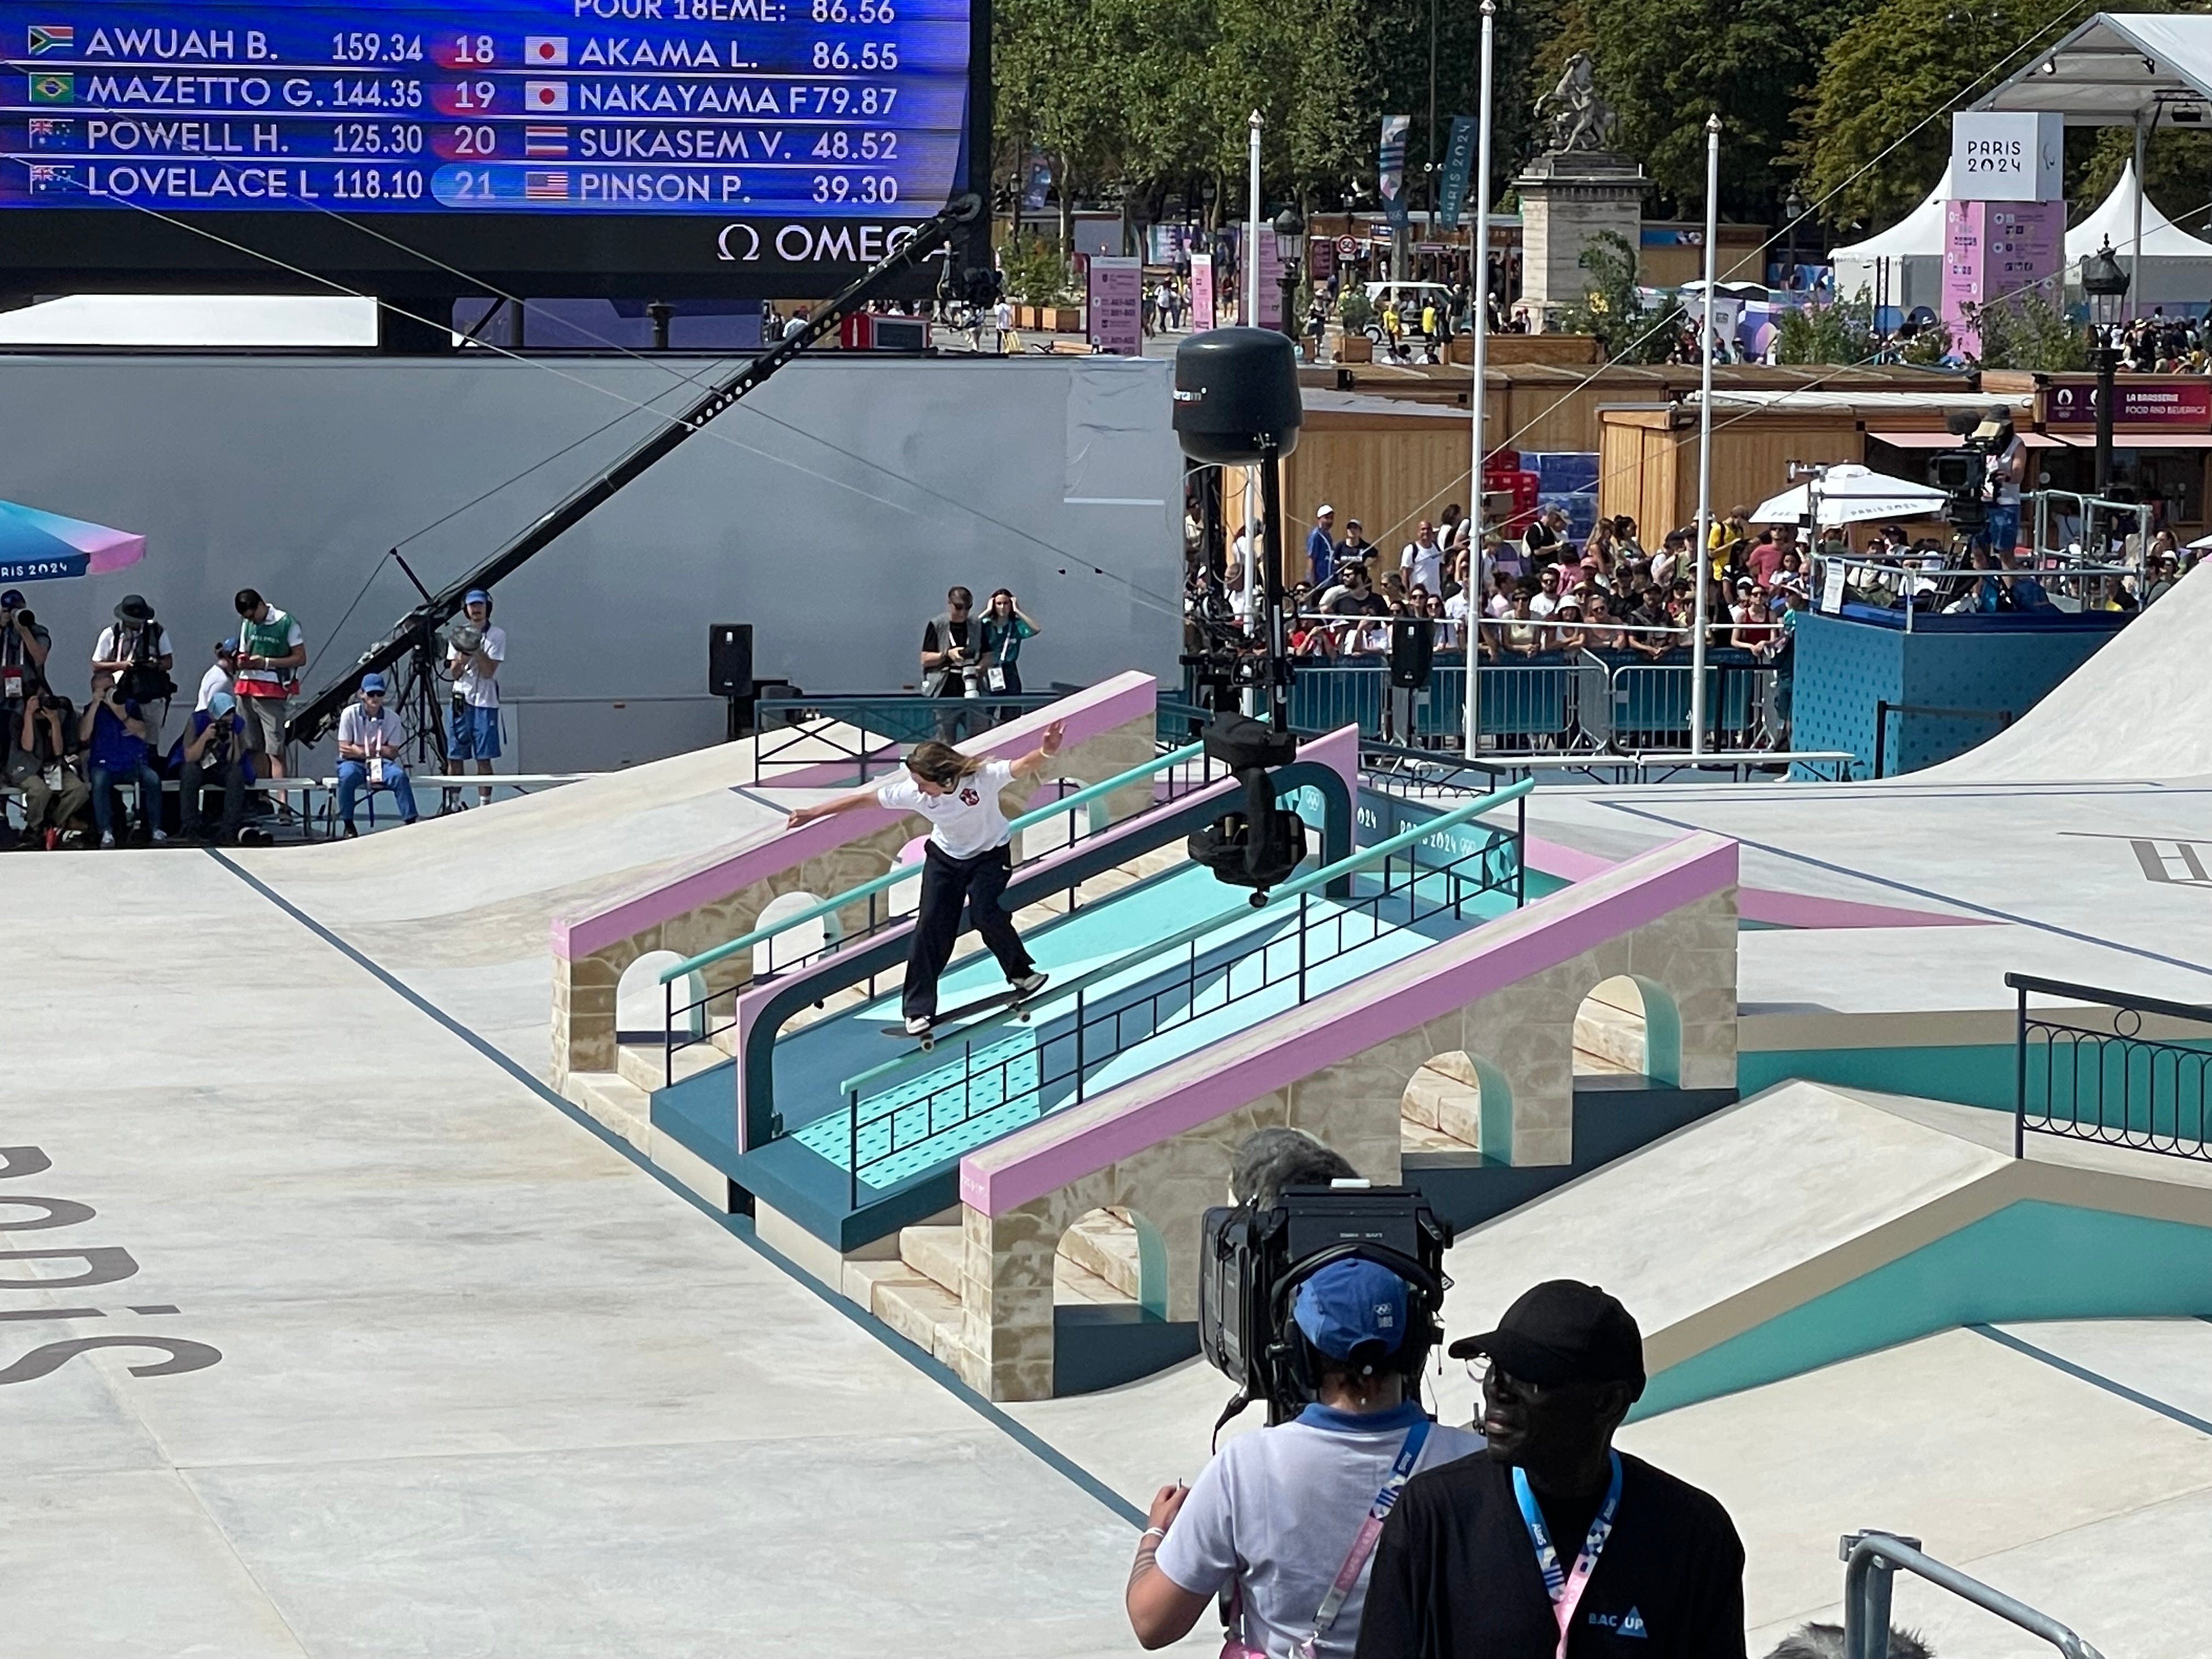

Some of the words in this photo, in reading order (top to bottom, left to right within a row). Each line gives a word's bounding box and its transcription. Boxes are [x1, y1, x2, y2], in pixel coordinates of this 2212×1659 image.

[574, 0, 663, 19] POUR
[811, 0, 895, 24] 86.56
[85, 28, 235, 60] AWUAH
[246, 32, 279, 60] B.
[332, 32, 424, 62] 159.34
[455, 35, 494, 63] 18
[578, 37, 720, 68] AKAMA
[731, 40, 758, 69] L.
[812, 42, 898, 70] 86.55
[87, 75, 271, 106] MAZETTO
[283, 78, 324, 108] G.
[332, 80, 422, 108] 144.35
[455, 80, 495, 108] 19
[579, 83, 781, 114] NAKAYAMA
[790, 87, 807, 113] F
[813, 87, 898, 115] 79.87
[88, 121, 243, 151] POWELL
[254, 124, 289, 153] H.
[333, 124, 423, 154] 125.30
[454, 126, 496, 155] 20
[579, 128, 749, 159] SUKASEM
[759, 131, 792, 159] V.
[811, 131, 898, 160] 48.52
[1452, 124, 1470, 167] 2024
[1967, 140, 2021, 155] PARIS
[1967, 159, 2021, 173] 2024
[88, 167, 287, 197] LOVELACE
[300, 170, 319, 199] L
[334, 170, 423, 199] 118.10
[454, 171, 496, 199] 21
[580, 172, 710, 202] PINSON
[722, 176, 751, 202] P.
[813, 176, 898, 204] 39.30
[1342, 241, 1352, 250] 50
[2126, 393, 2136, 402] LA
[2125, 406, 2149, 414] FOOD
[2149, 406, 2166, 414] AND
[2166, 406, 2207, 414] BEVERAGE
[1850, 507, 1885, 516] PARIS
[1886, 503, 1918, 511] 2024
[29, 562, 67, 576] 2024
[1357, 806, 1377, 830] 024
[1430, 832, 1457, 854] 2024
[1588, 1612, 1618, 1627] BAC
[1624, 1616, 1644, 1630] UP
